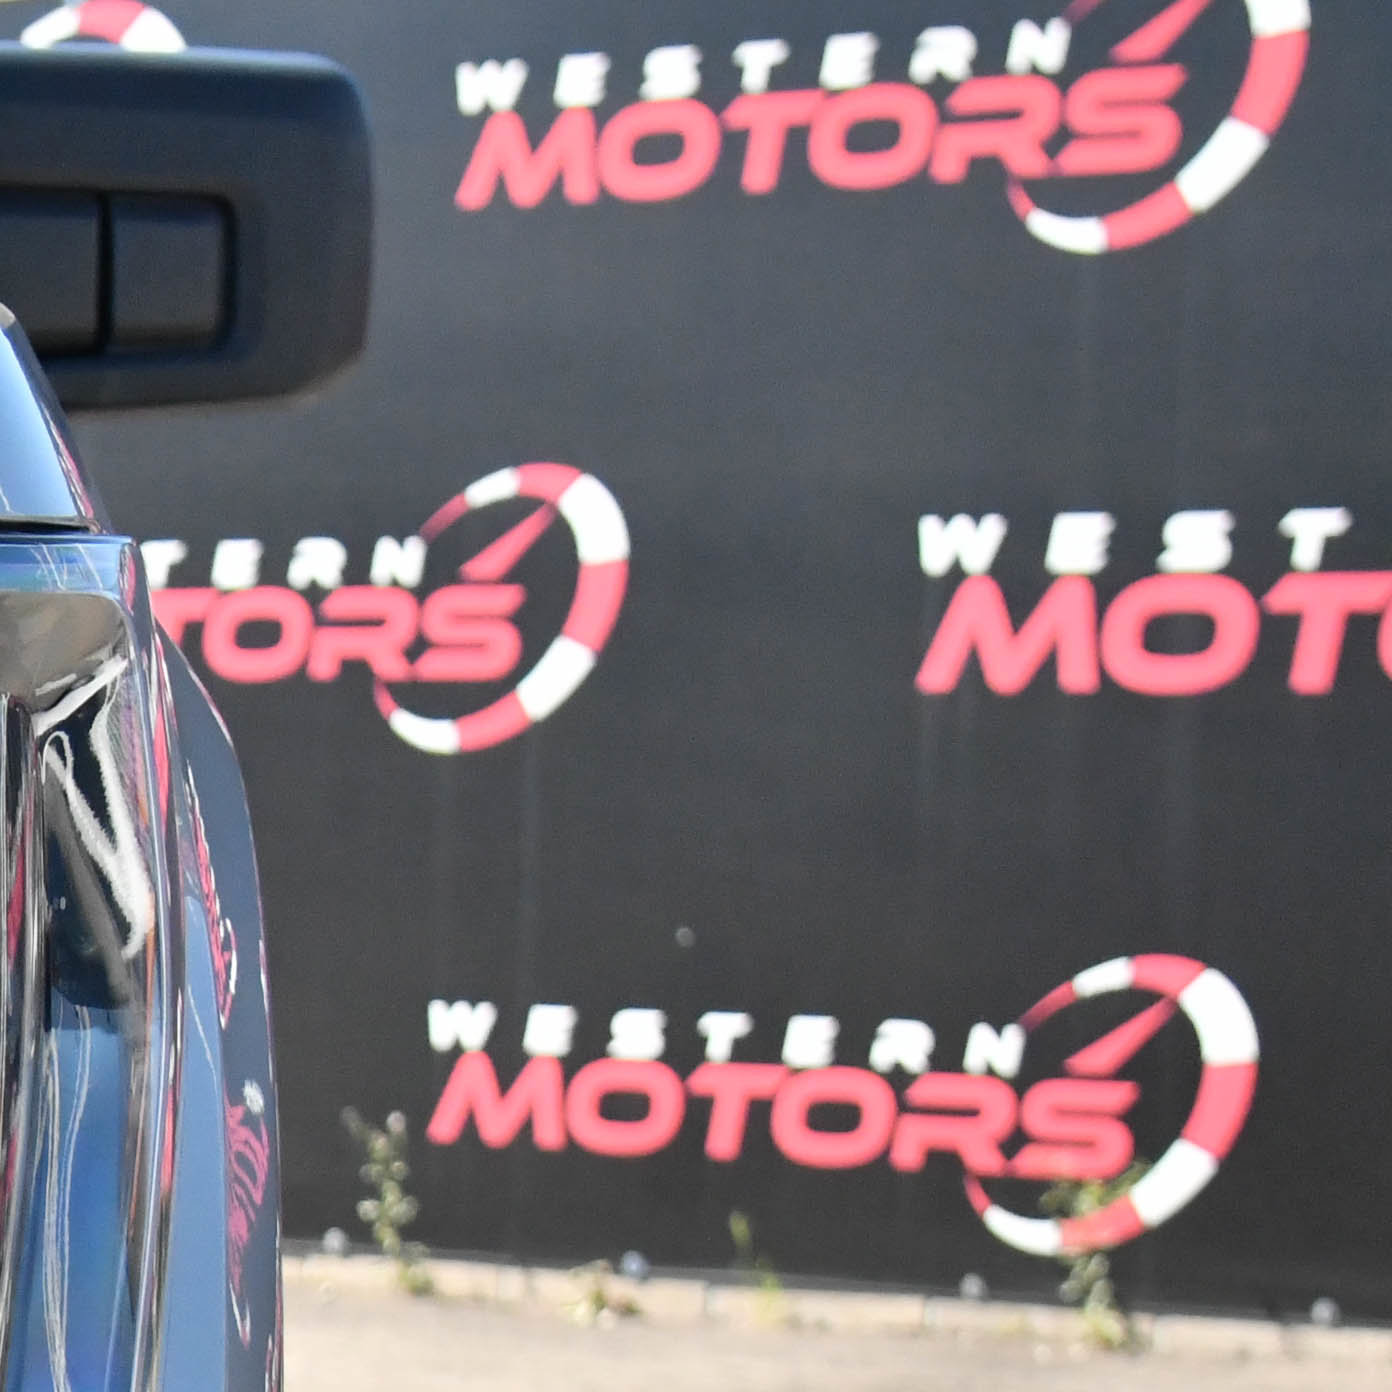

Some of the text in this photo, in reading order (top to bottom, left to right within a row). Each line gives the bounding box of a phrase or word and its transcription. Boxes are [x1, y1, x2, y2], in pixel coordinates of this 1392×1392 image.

[455, 18, 1073, 116] WESTERN
[454, 62, 1189, 211] MOTORS
[918, 506, 1353, 577] WEST
[914, 570, 1392, 697] MOT
[427, 999, 1026, 1080] WESTERN
[425, 1050, 1141, 1181] MOTORS
